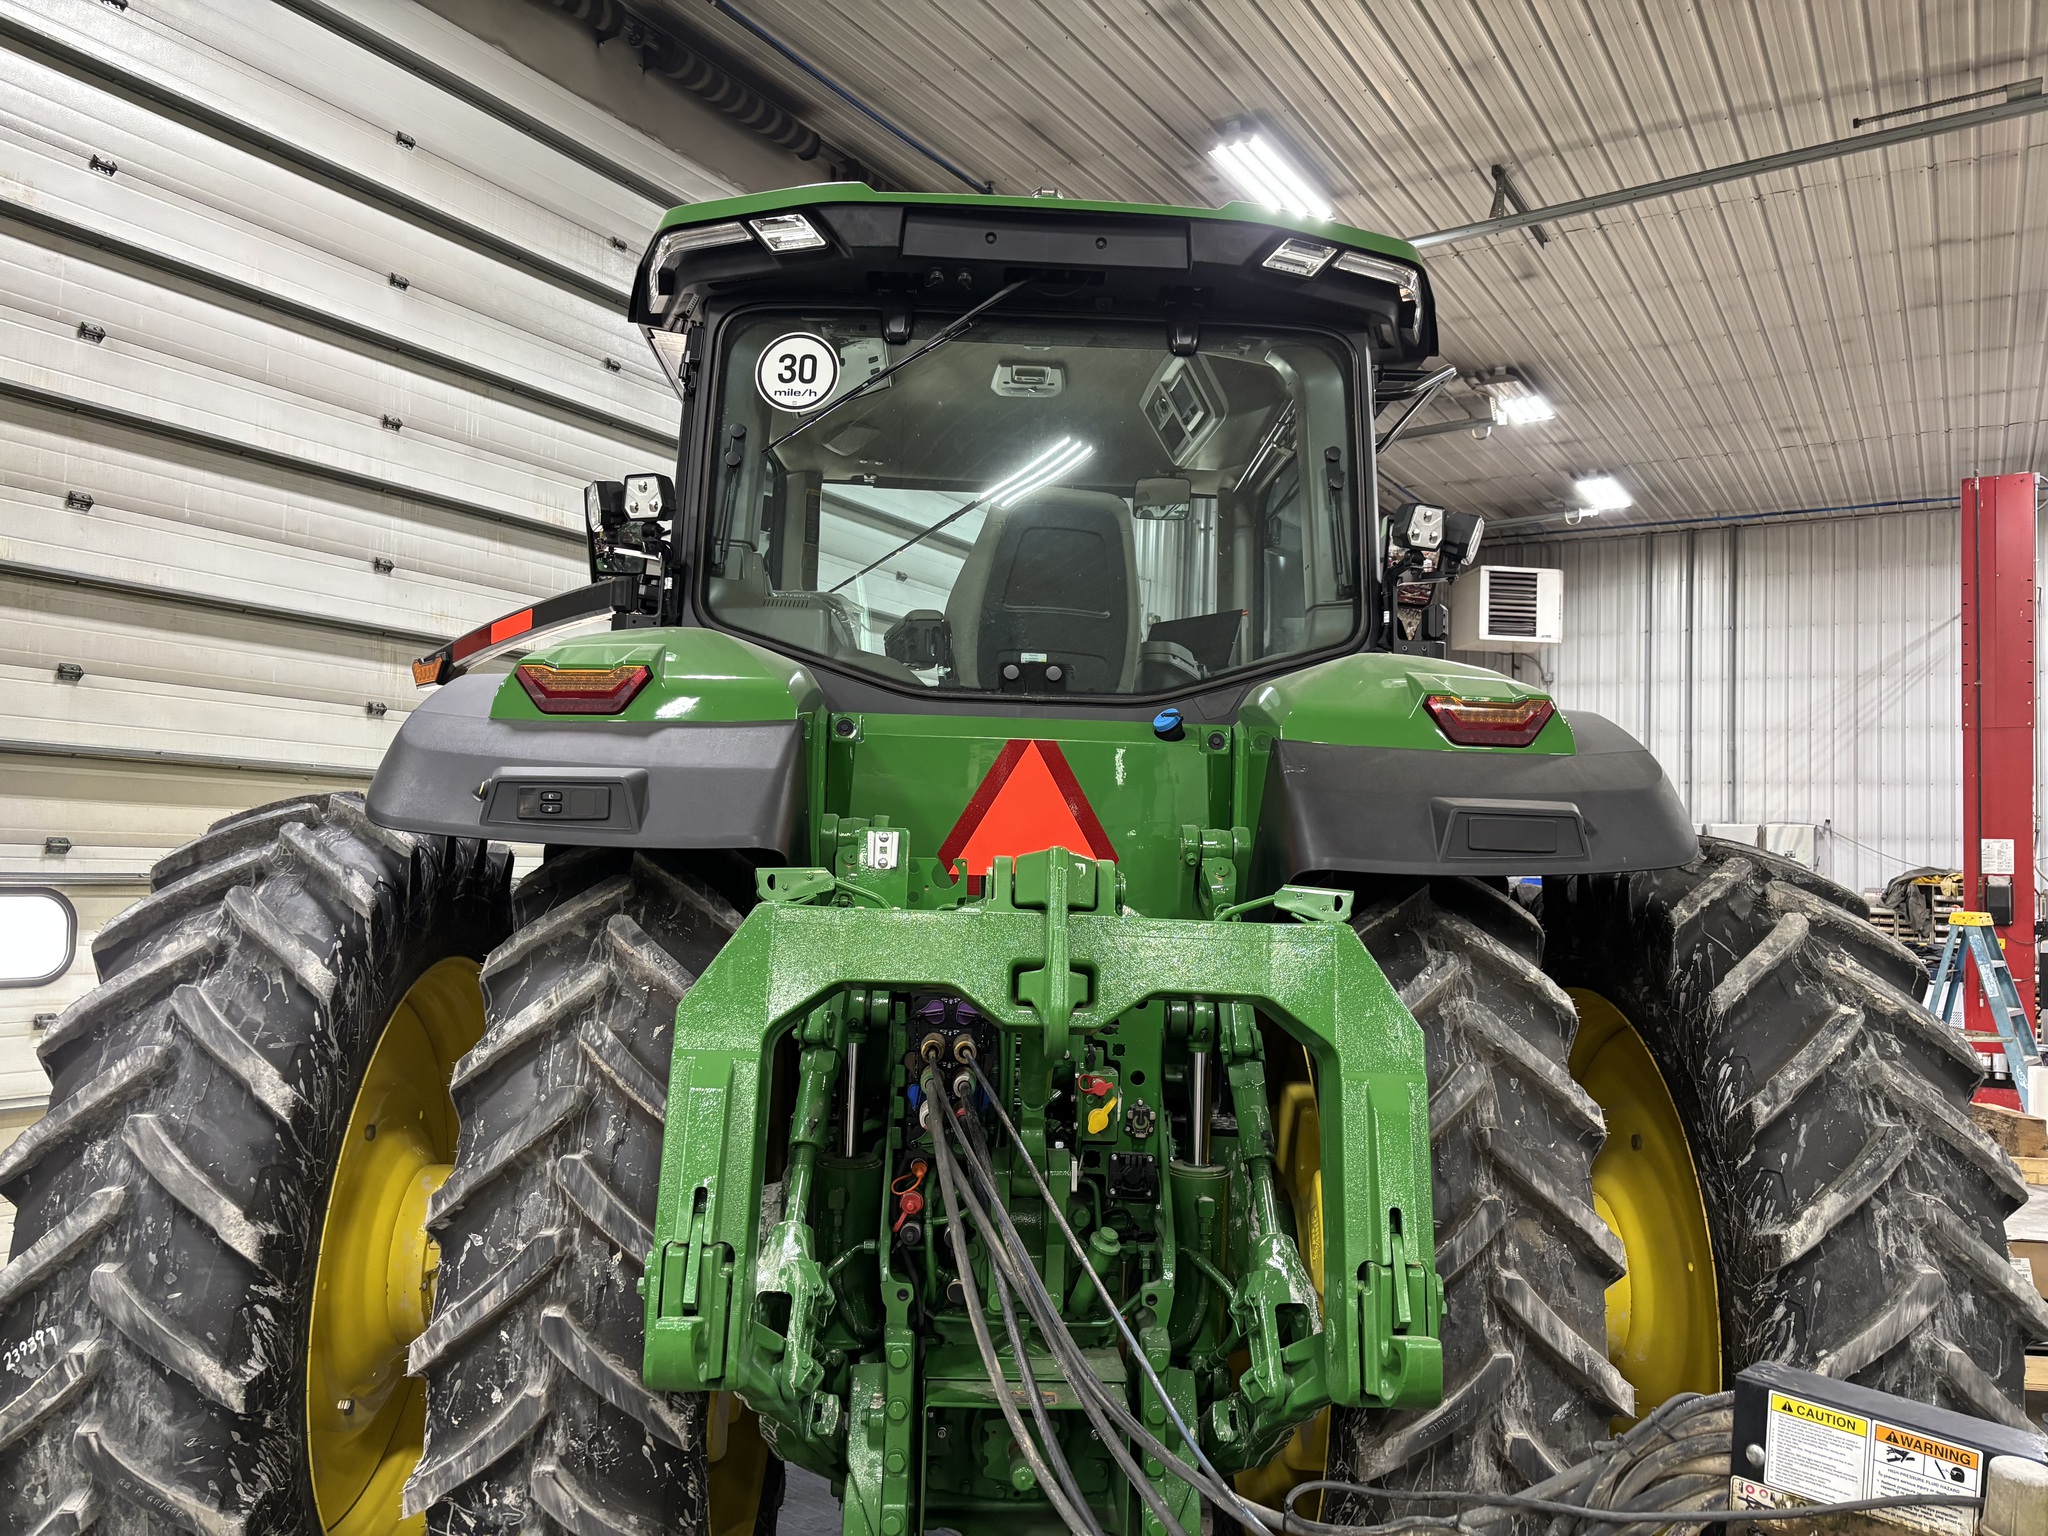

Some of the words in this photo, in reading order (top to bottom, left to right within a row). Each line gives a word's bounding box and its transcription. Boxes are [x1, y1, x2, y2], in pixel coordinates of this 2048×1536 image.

[778, 354, 817, 384] 30
[774, 389, 817, 397] mile/h
[1796, 1405, 1857, 1431] CAUTION
[1901, 1434, 1971, 1466] WARNING
[1900, 1472, 1924, 1483] PRESSURE
[1926, 1480, 1939, 1488] FLUID
[1940, 1484, 1960, 1494] HAZARD
[1936, 1510, 1958, 1520] protection
